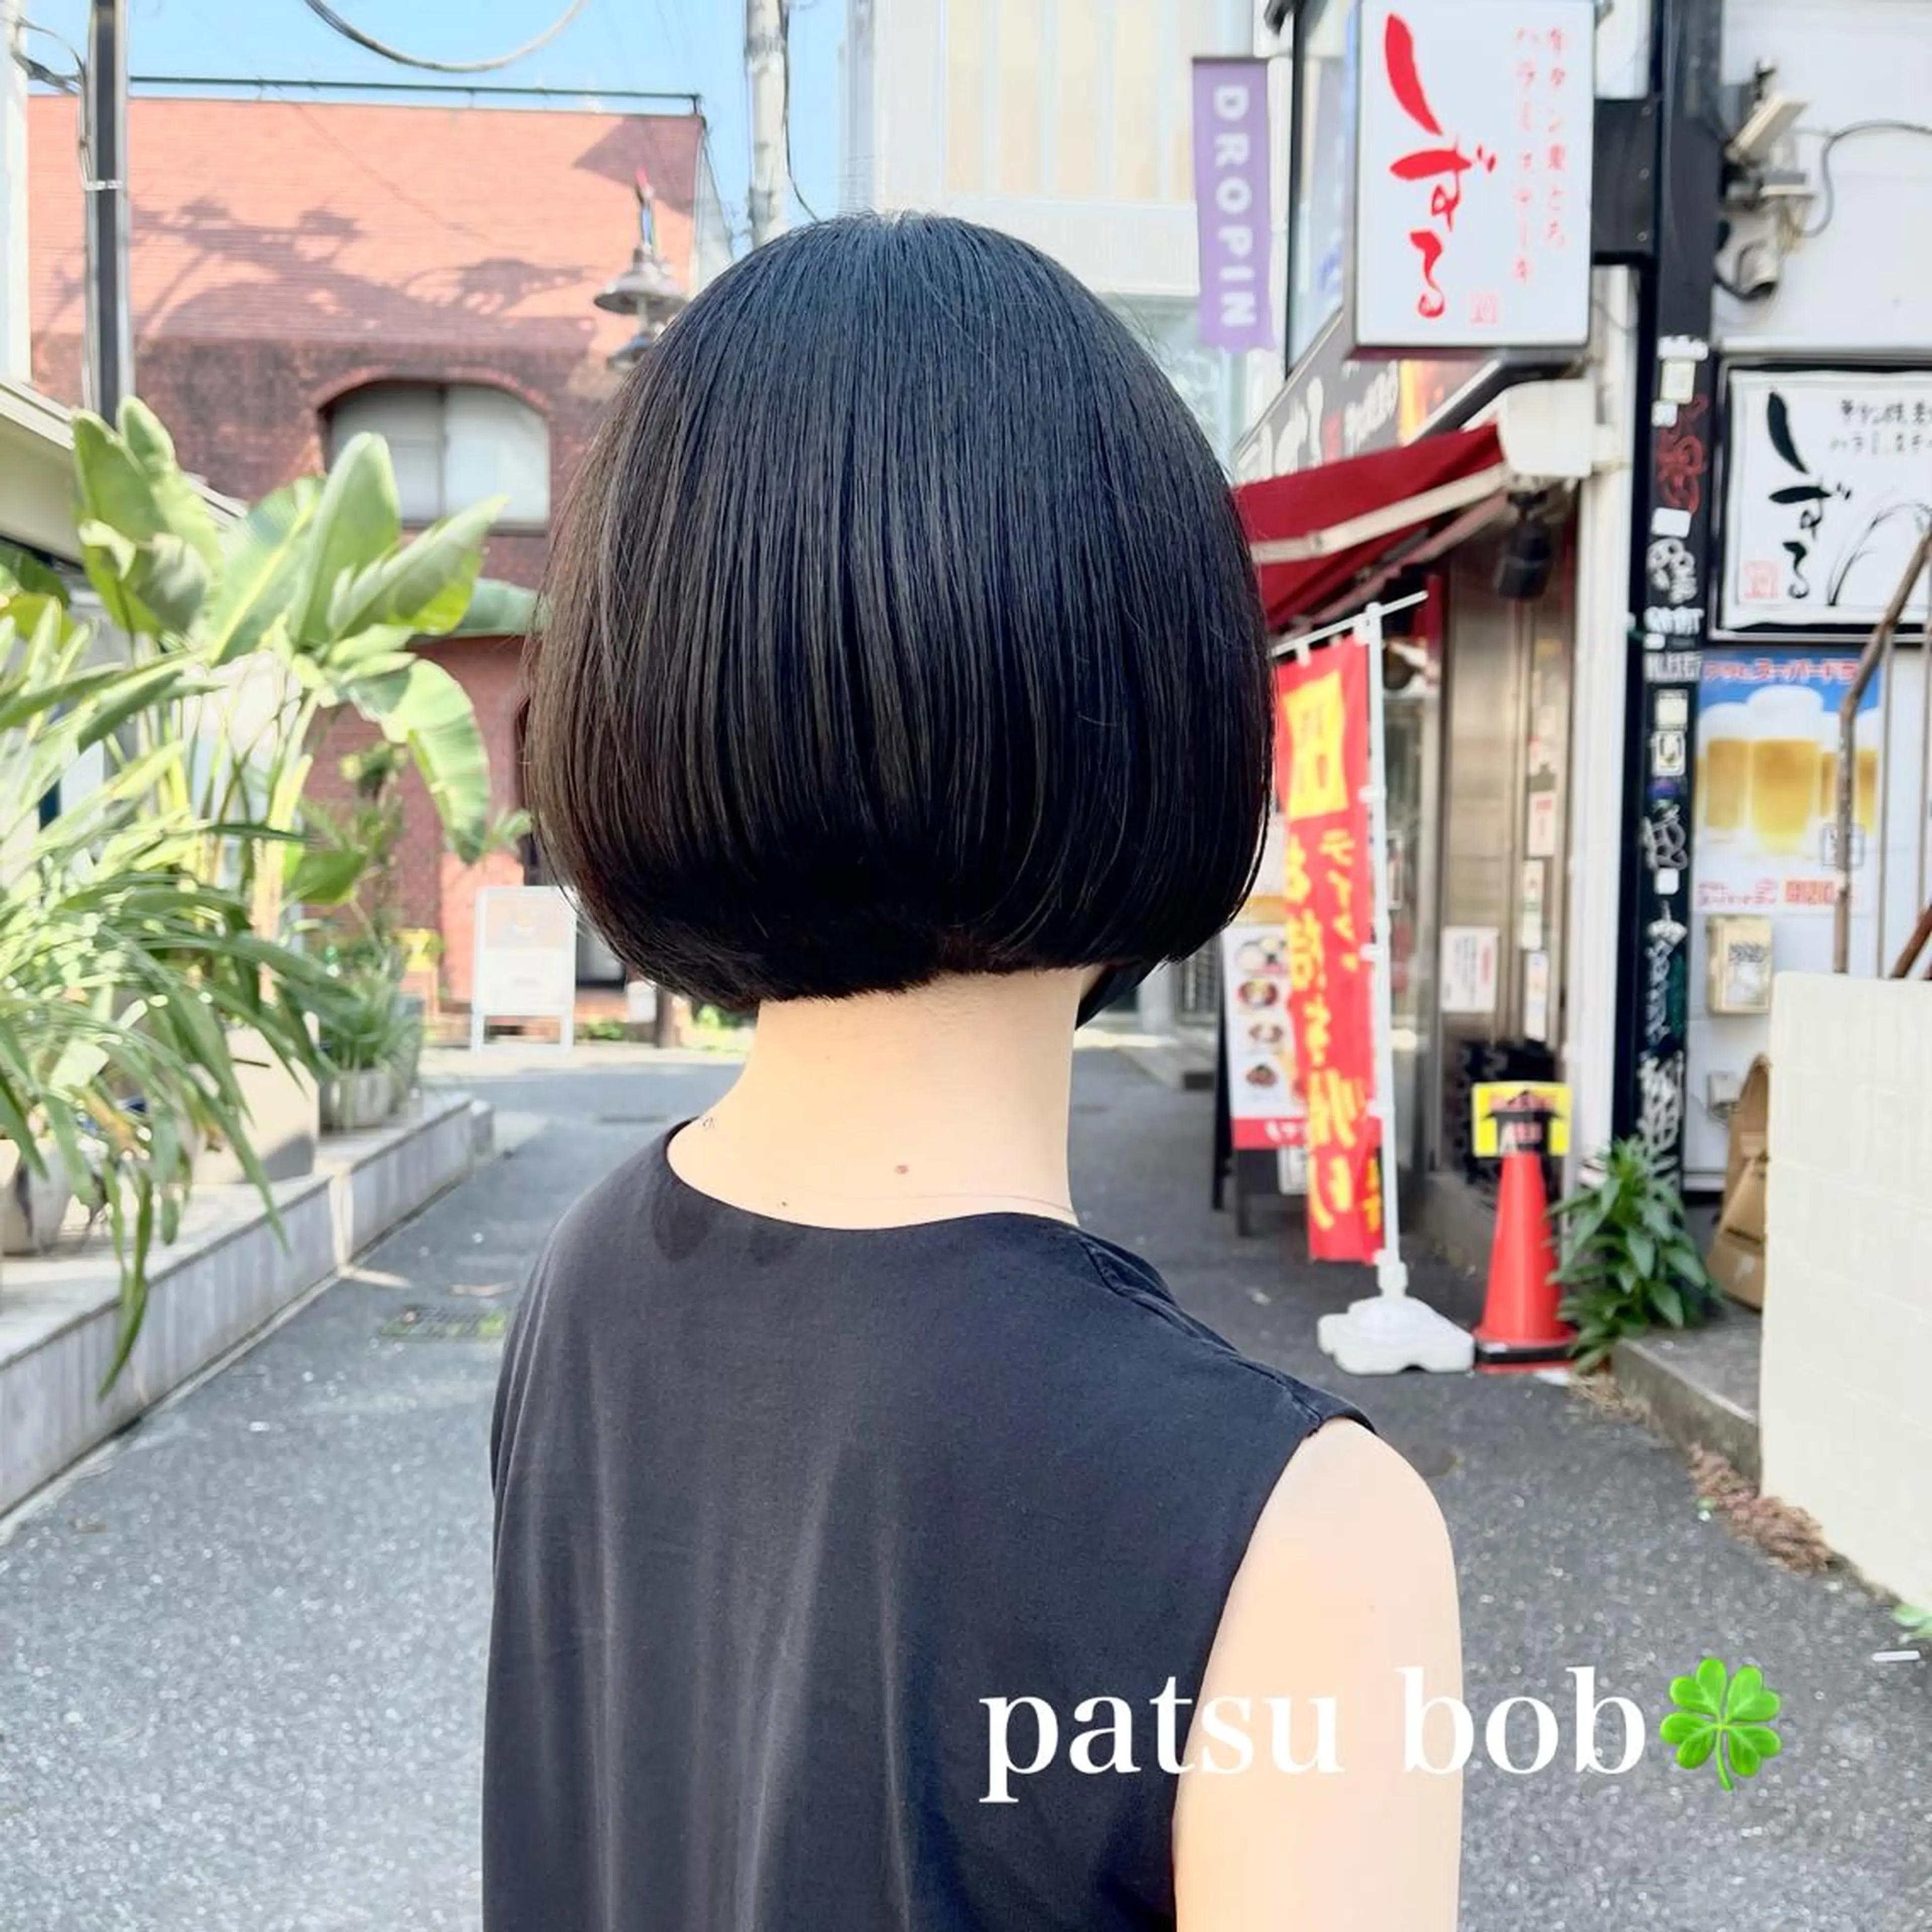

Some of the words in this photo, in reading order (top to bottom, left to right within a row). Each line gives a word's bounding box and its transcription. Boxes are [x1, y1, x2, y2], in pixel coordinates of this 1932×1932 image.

[1384, 13, 1497, 318] しずる
[1767, 385, 1853, 599] しずる
